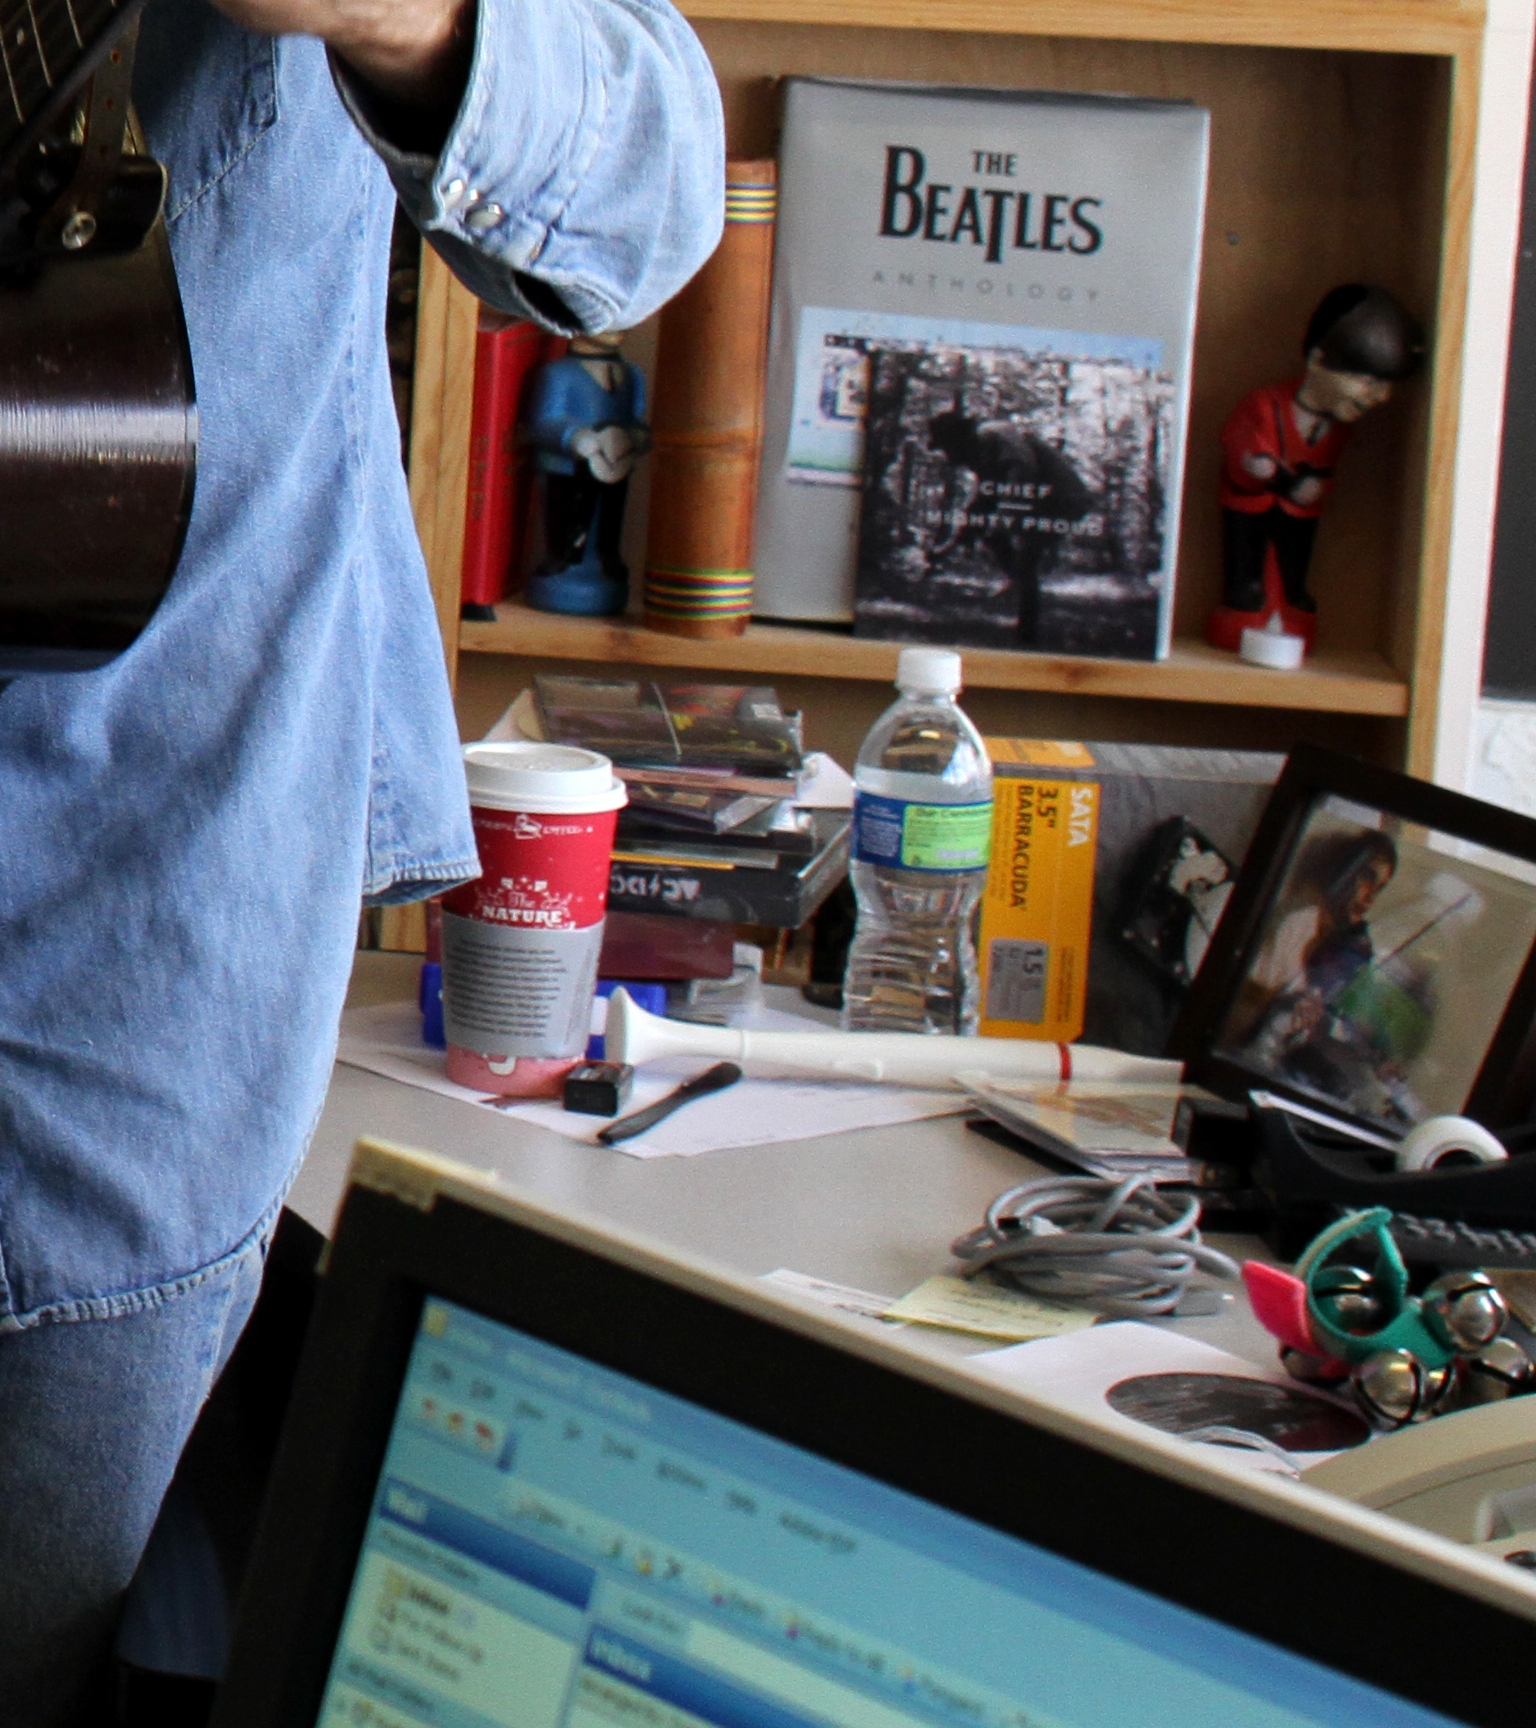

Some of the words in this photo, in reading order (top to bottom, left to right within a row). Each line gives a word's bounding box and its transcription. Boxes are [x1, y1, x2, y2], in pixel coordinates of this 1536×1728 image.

[971, 150, 1017, 176] THE
[878, 144, 1105, 264] BEATLES
[873, 270, 1100, 303] ANTHOLOGY
[979, 481, 1053, 499] CHIEF
[926, 509, 1016, 530] MIGHTY
[1022, 517, 1104, 538] PROUD
[1066, 787, 1091, 848] SATA
[1011, 784, 1035, 909] BARRACUDA
[481, 904, 564, 924] NATURE
